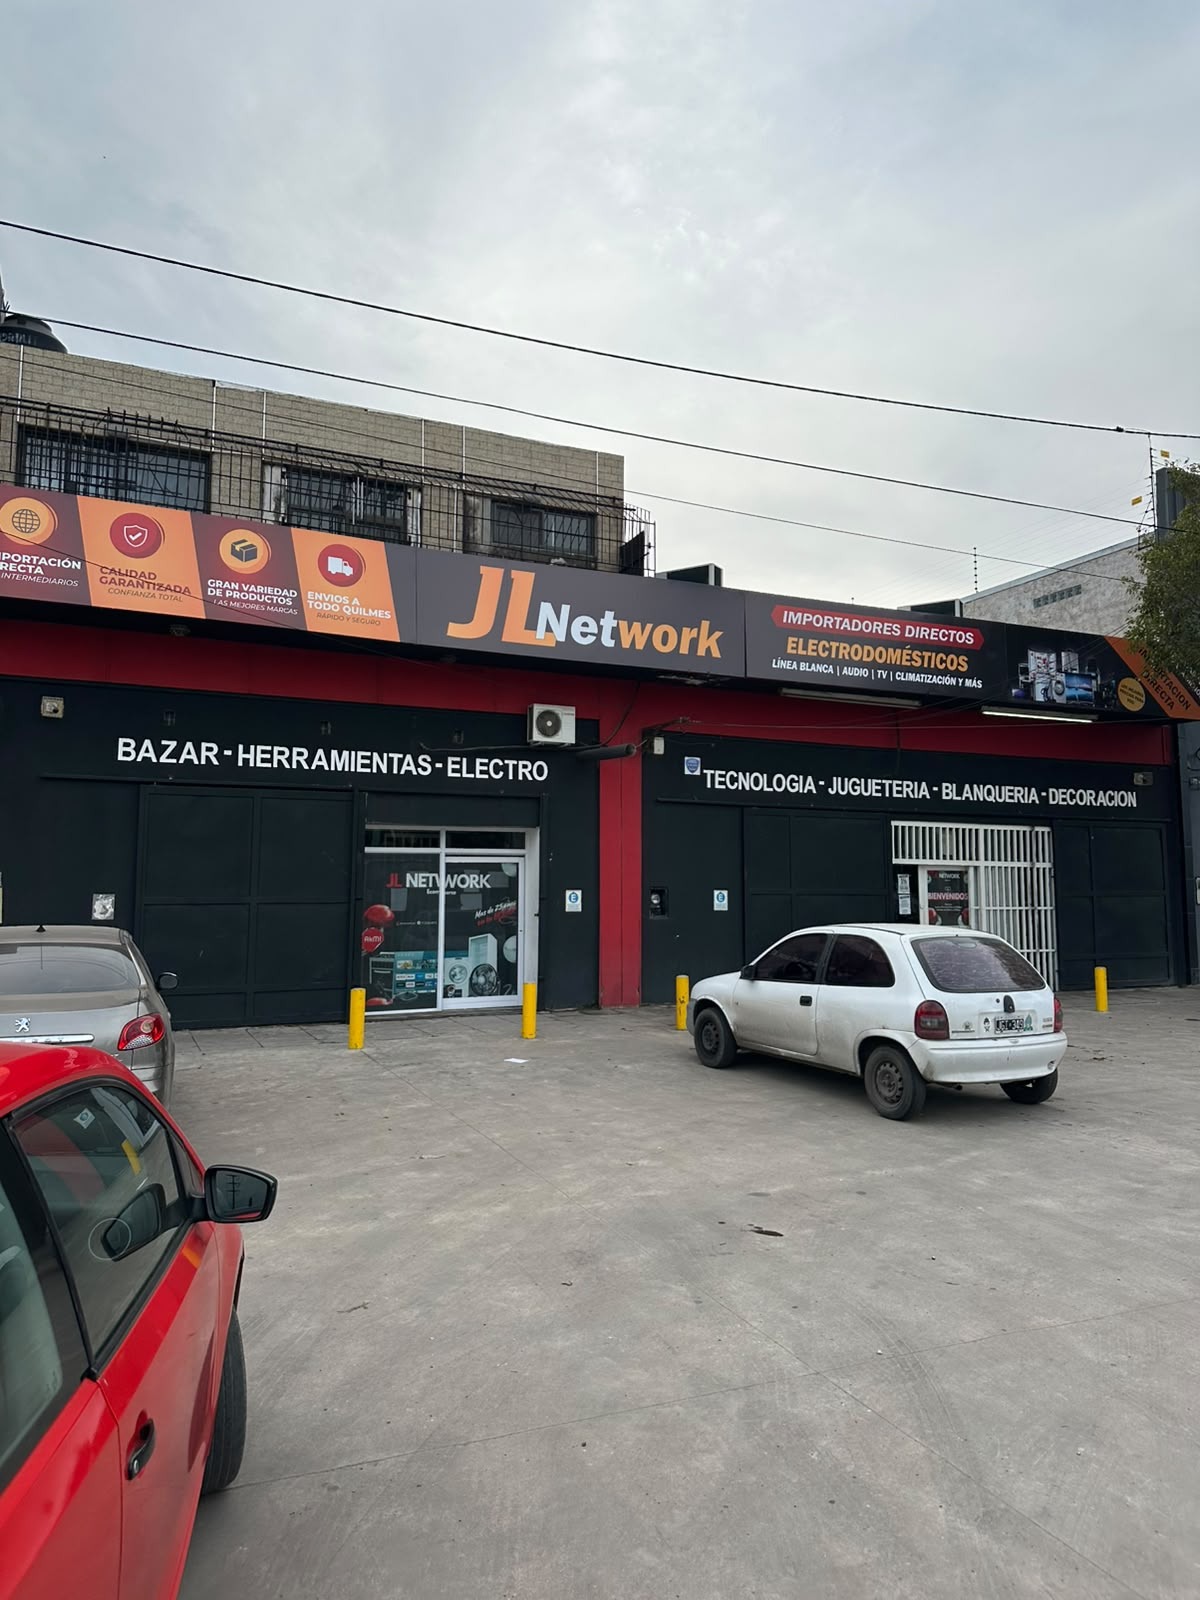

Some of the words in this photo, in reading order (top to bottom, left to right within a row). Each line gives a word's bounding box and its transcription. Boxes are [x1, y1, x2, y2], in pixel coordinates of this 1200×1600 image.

[1, 572, 79, 587] INTERMEDIARIOS
[100, 566, 157, 581] CALIDAD
[99, 576, 191, 595] GARANTIZADA
[108, 587, 156, 599] CONFIANZA
[158, 593, 183, 602] TOTAL
[207, 579, 239, 590] GRAN
[241, 583, 298, 598] VARIEDAD
[207, 588, 223, 597] DE
[225, 590, 293, 606] PRODUCTOS
[307, 591, 350, 604] ENVIOS
[351, 597, 360, 606] A
[229, 601, 265, 611] MEJORES
[266, 606, 298, 615] MARCAS
[307, 600, 340, 612] TODO
[342, 605, 391, 619] QUILMES
[446, 565, 557, 647] JL
[535, 601, 724, 658] Network
[782, 610, 901, 636] IMPORTADORES
[904, 625, 975, 645] DIRECTOS
[786, 636, 969, 672] ELECTRODOMÉSTICOS
[772, 657, 798, 671] LÍNEA
[799, 661, 834, 674] BLANCA
[842, 666, 869, 678] AUDIO
[876, 669, 889, 679] TV
[895, 671, 957, 686] CLIMATIZACIÓN
[958, 677, 964, 687] Y
[964, 677, 983, 689] MÁS
[386, 873, 403, 889] JL
[405, 873, 492, 889] NETWORK
